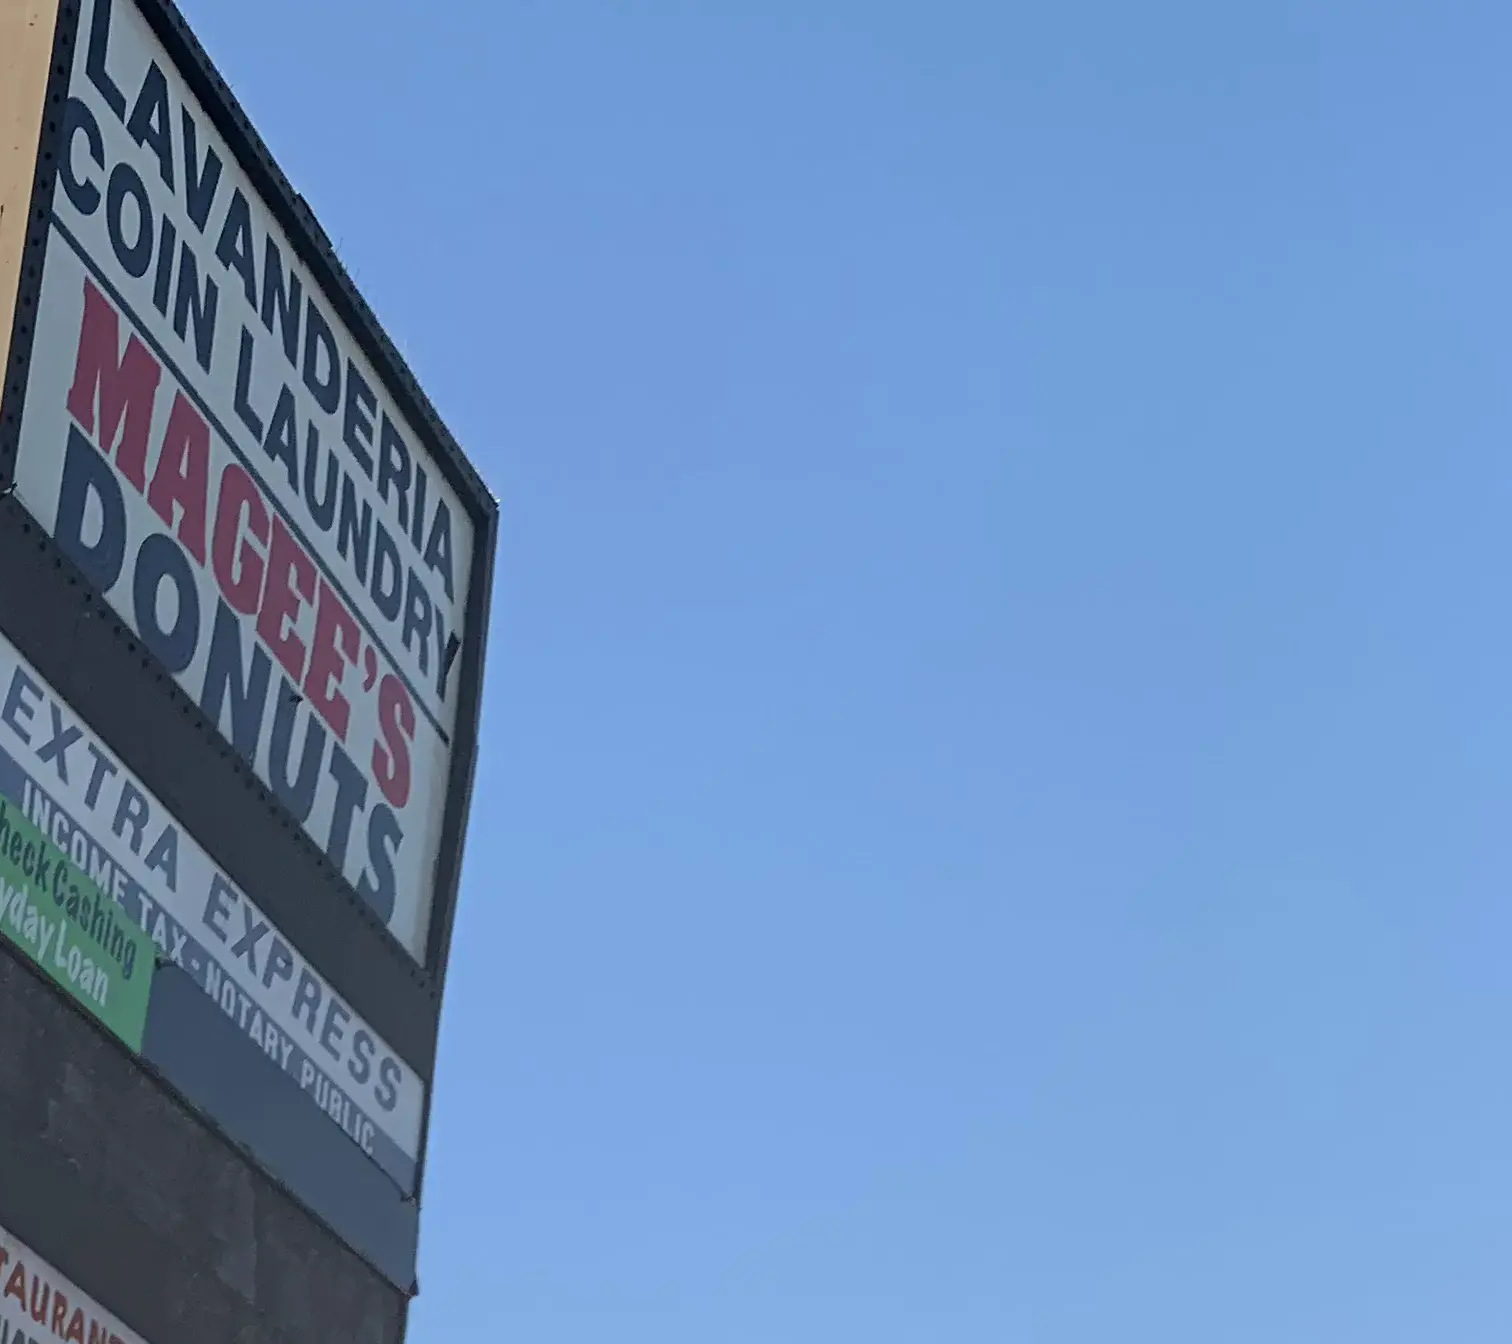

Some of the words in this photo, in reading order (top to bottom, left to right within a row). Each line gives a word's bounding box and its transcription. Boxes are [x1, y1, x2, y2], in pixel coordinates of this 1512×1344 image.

[56, 96, 220, 375] COIN
[234, 325, 461, 703] LAUNDRY
[86, 0, 455, 603] LAVANDERIA
[53, 422, 404, 930] DONUTS
[66, 276, 415, 810] MAGEE'S
[0, 664, 179, 893] EXTRA
[202, 872, 403, 1112] EXPRESS
[22, 778, 129, 903] INCOME
[138, 893, 188, 968] TAX
[205, 960, 295, 1071] NOTARY
[300, 1058, 376, 1156] PUBLIC
[52, 859, 137, 981] Cashing
[54, 918, 110, 1008] Loan
